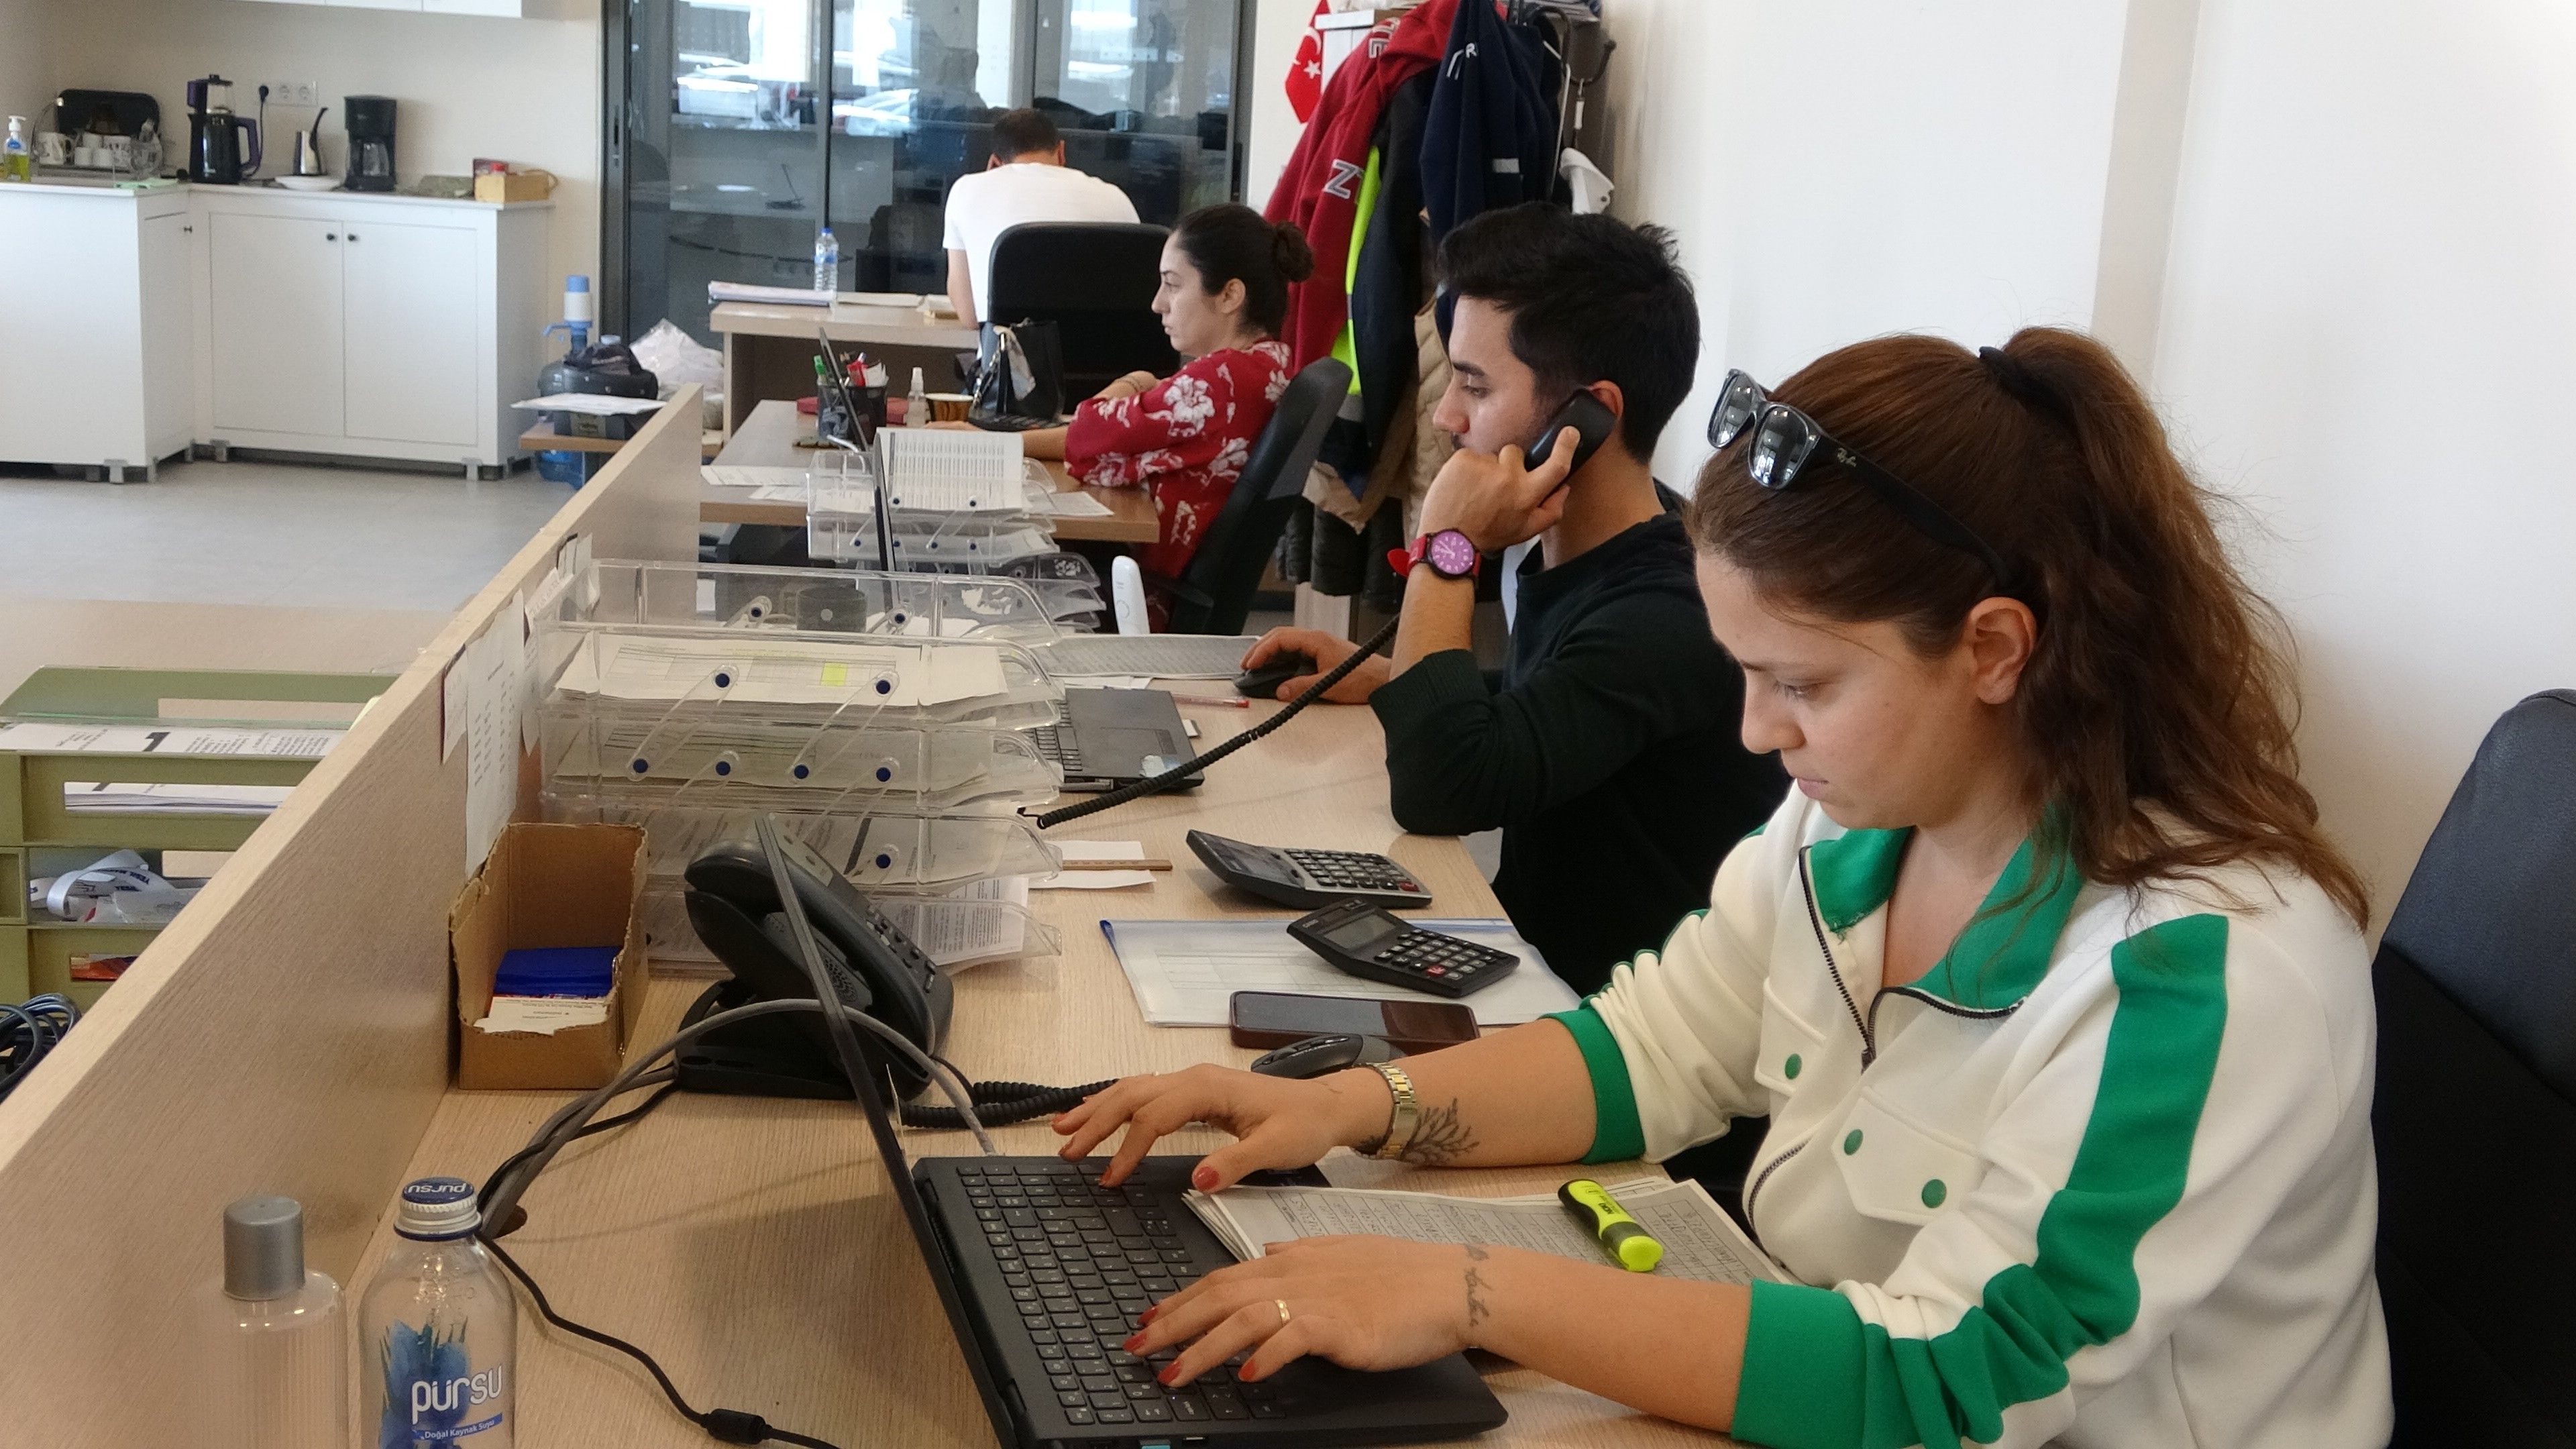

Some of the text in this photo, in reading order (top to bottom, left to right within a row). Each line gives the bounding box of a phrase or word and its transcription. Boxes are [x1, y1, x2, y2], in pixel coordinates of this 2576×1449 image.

[1322, 158, 1364, 199] Z
[425, 1430, 448, 1440] Doğal
[450, 1426, 477, 1436] Kaynak
